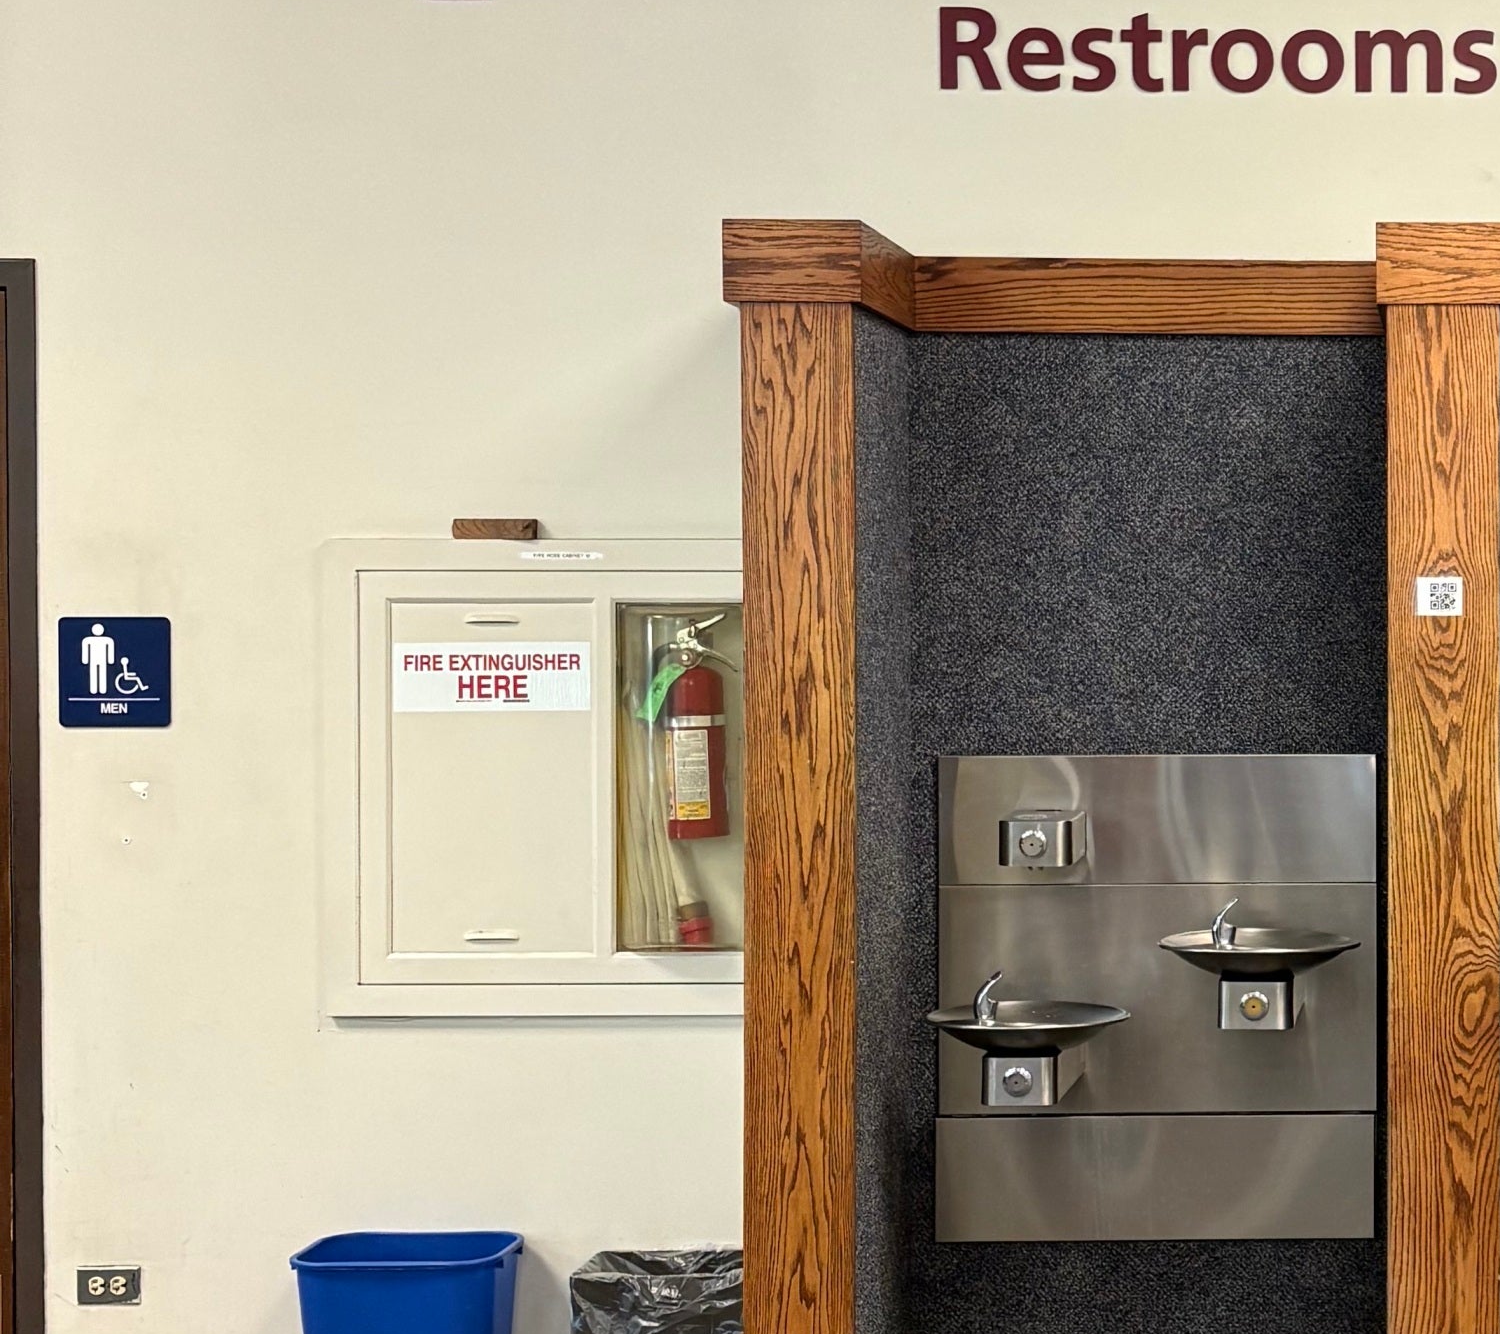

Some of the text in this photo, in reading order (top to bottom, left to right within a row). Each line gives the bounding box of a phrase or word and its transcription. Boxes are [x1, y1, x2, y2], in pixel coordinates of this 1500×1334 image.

[939, 7, 1497, 93] Restrooms
[403, 653, 581, 672] FIRE EXTINGUISHER
[457, 675, 528, 699] HERE
[100, 703, 128, 714] MEN
